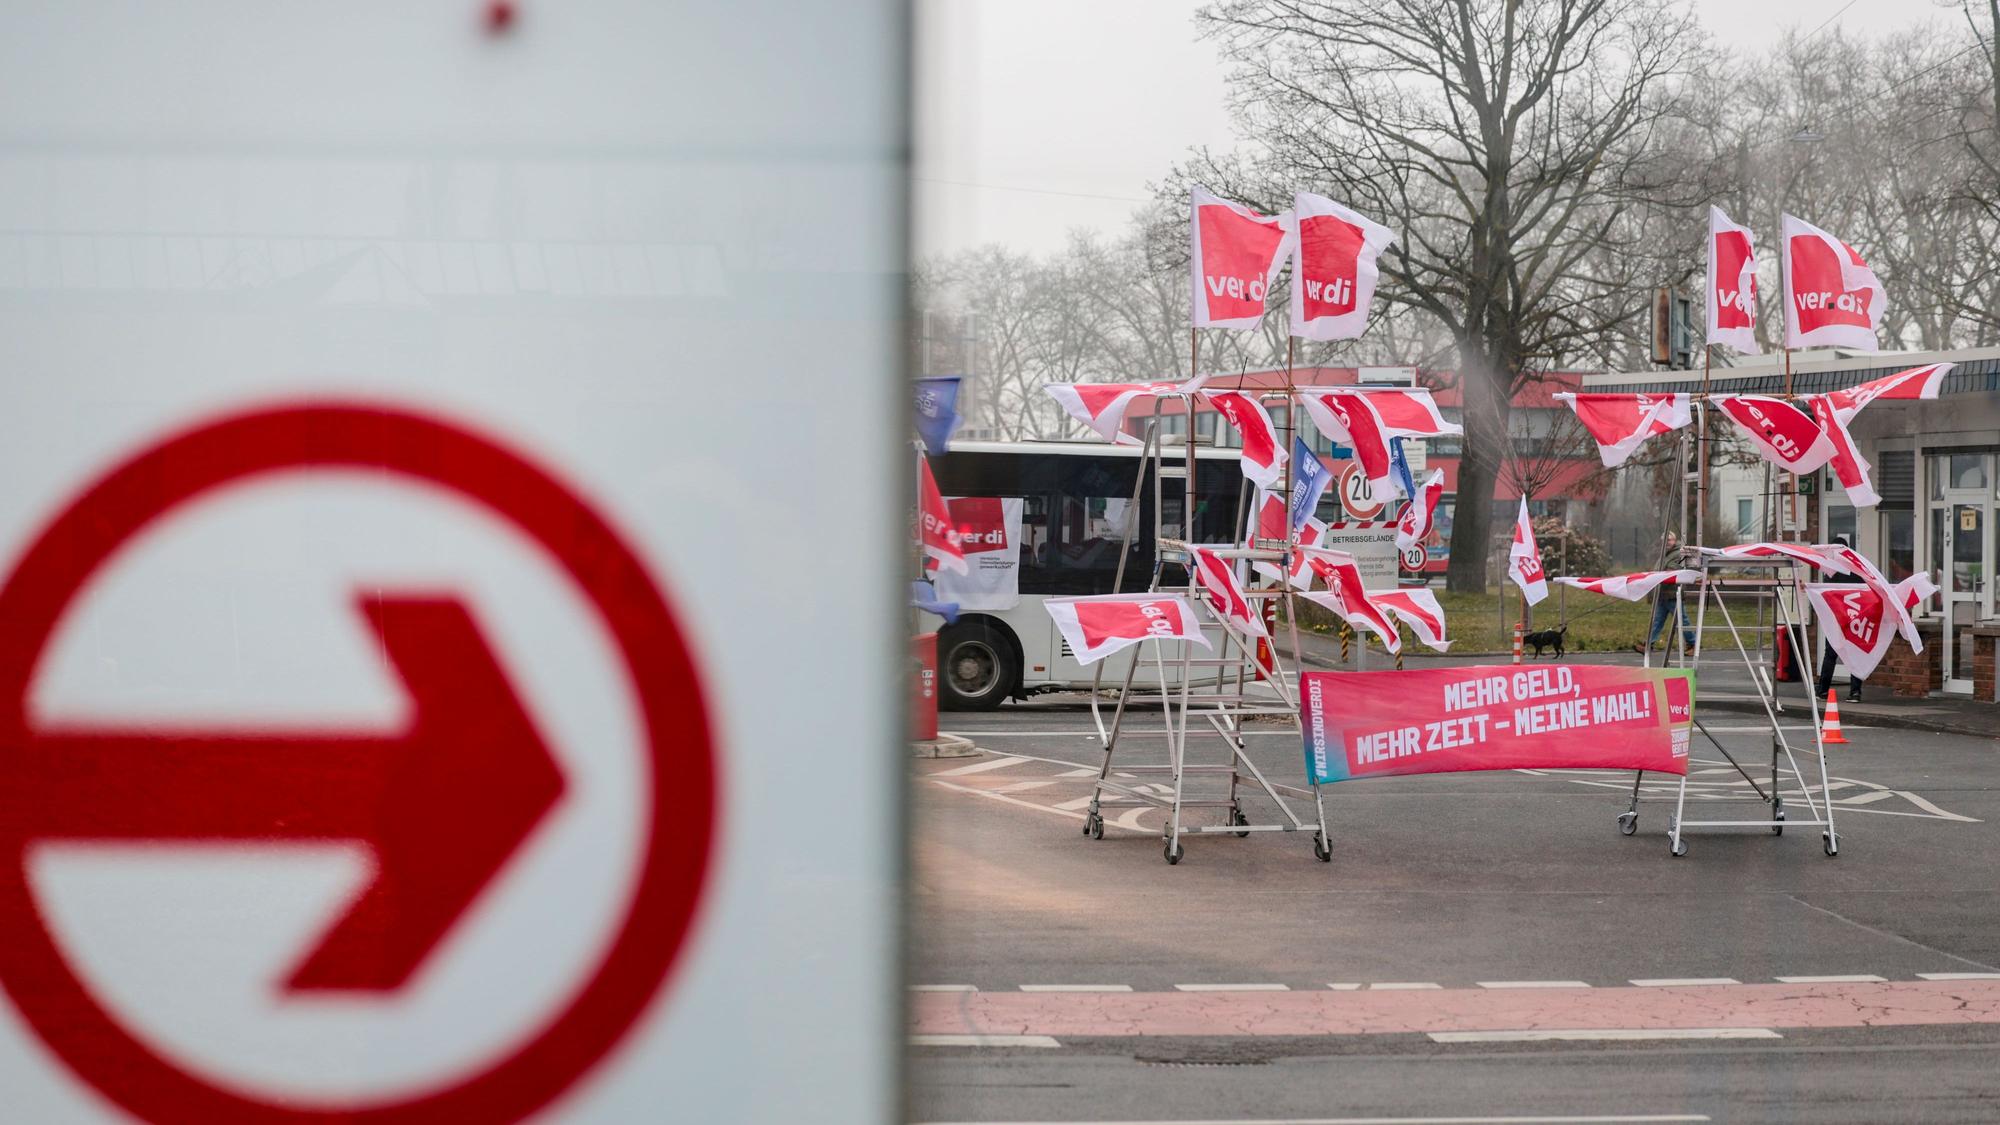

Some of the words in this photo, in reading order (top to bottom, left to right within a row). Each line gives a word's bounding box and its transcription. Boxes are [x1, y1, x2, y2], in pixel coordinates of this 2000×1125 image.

[1352, 475, 1372, 501] 20
[1408, 550, 1421, 564] 20
[1444, 676, 1509, 712] MEHR
[1513, 666, 1580, 698] GELD,
[1308, 679, 1328, 777] #WIRSINDVERDI
[1357, 727, 1421, 764] MEHR
[1425, 714, 1489, 752] ZEIT
[1515, 698, 1590, 737] MEINE
[1592, 690, 1650, 724] WAHL!
